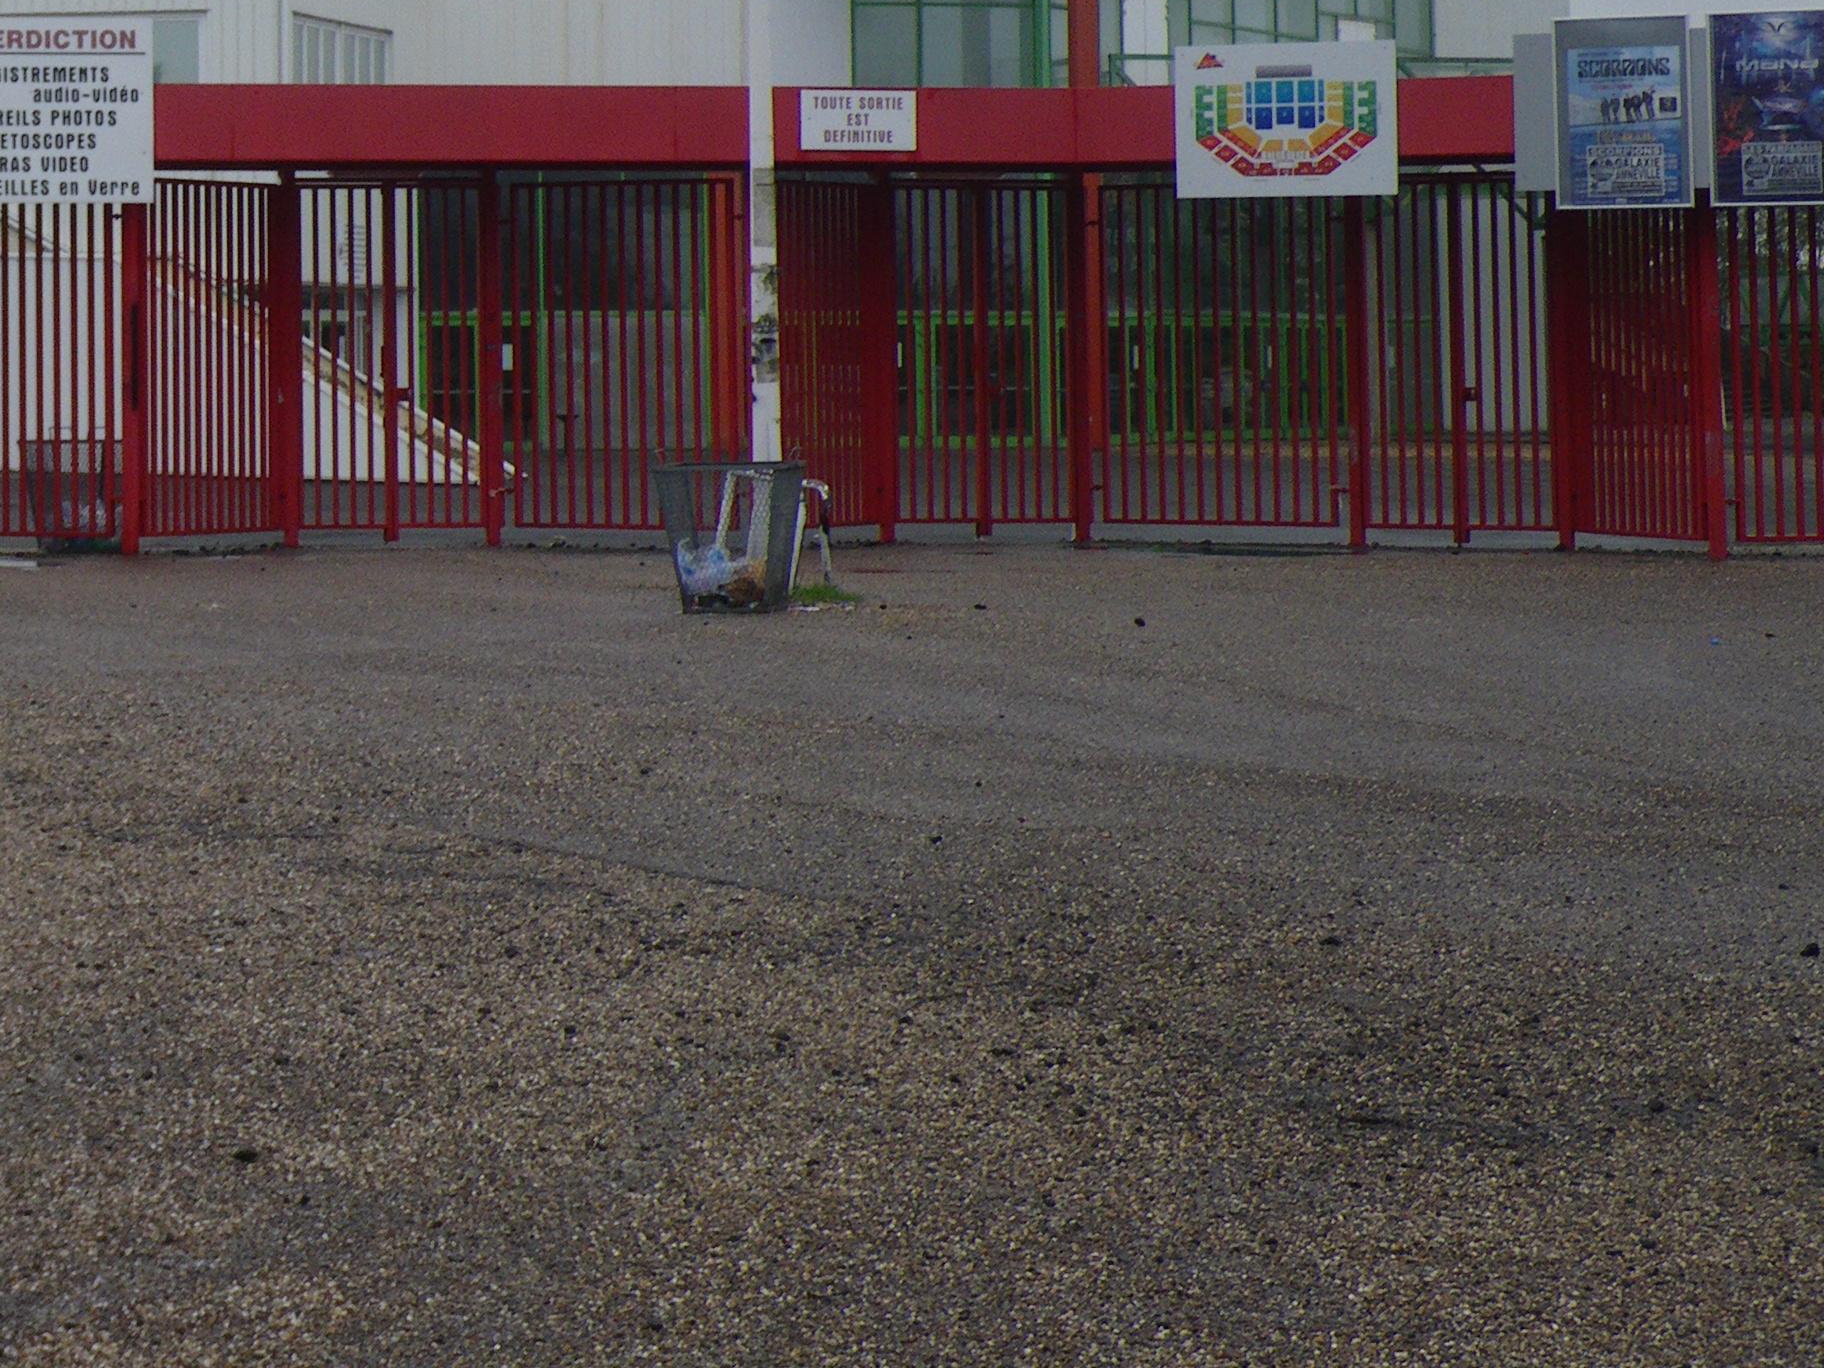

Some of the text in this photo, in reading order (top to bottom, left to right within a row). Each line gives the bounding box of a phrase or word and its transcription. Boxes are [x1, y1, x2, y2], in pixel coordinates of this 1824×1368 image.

[1577, 57, 1670, 78] SCORPIONS
[33, 85, 139, 103] audio-vidéo
[813, 96, 903, 110] TOUTE SORTIE
[50, 110, 117, 126] PHOTOS
[847, 113, 870, 127] EST
[823, 129, 893, 143] DEFINITIVE
[41, 156, 89, 173] VIDEO
[59, 181, 79, 196] en
